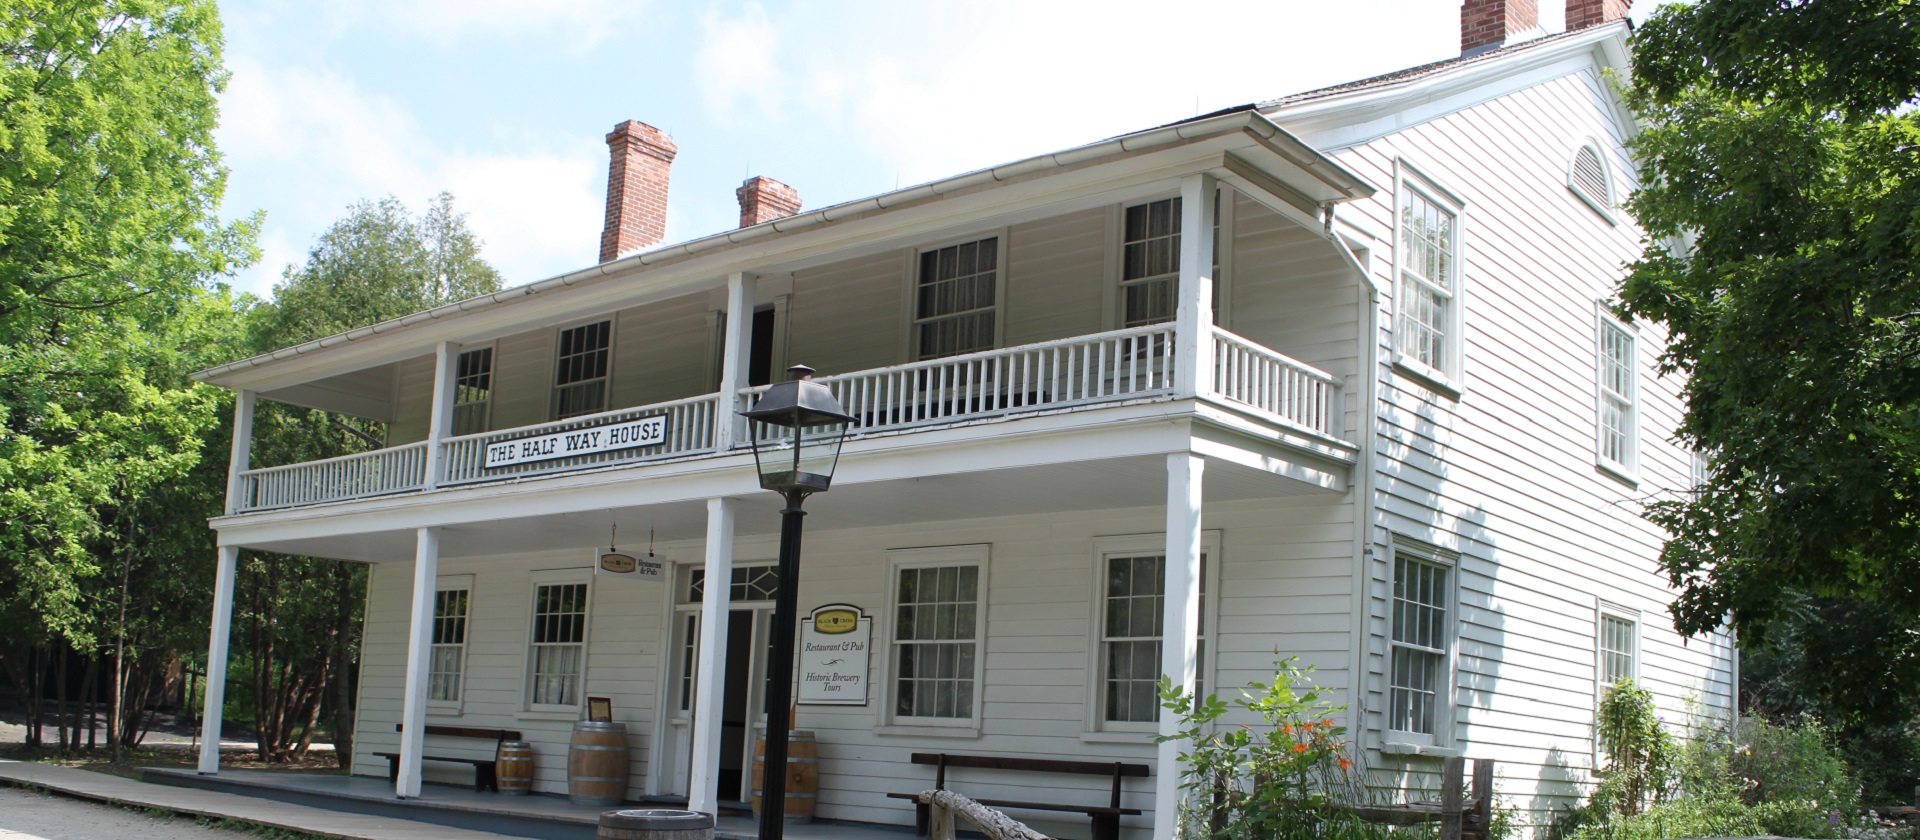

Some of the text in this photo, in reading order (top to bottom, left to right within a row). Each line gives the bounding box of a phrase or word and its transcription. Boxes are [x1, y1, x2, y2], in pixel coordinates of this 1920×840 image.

[490, 422, 661, 462] THE HALF WAY HOUSE
[805, 641, 864, 651] Restaurant & Pub
[806, 672, 860, 685] Historic Brewery
[823, 682, 841, 691] Tours
